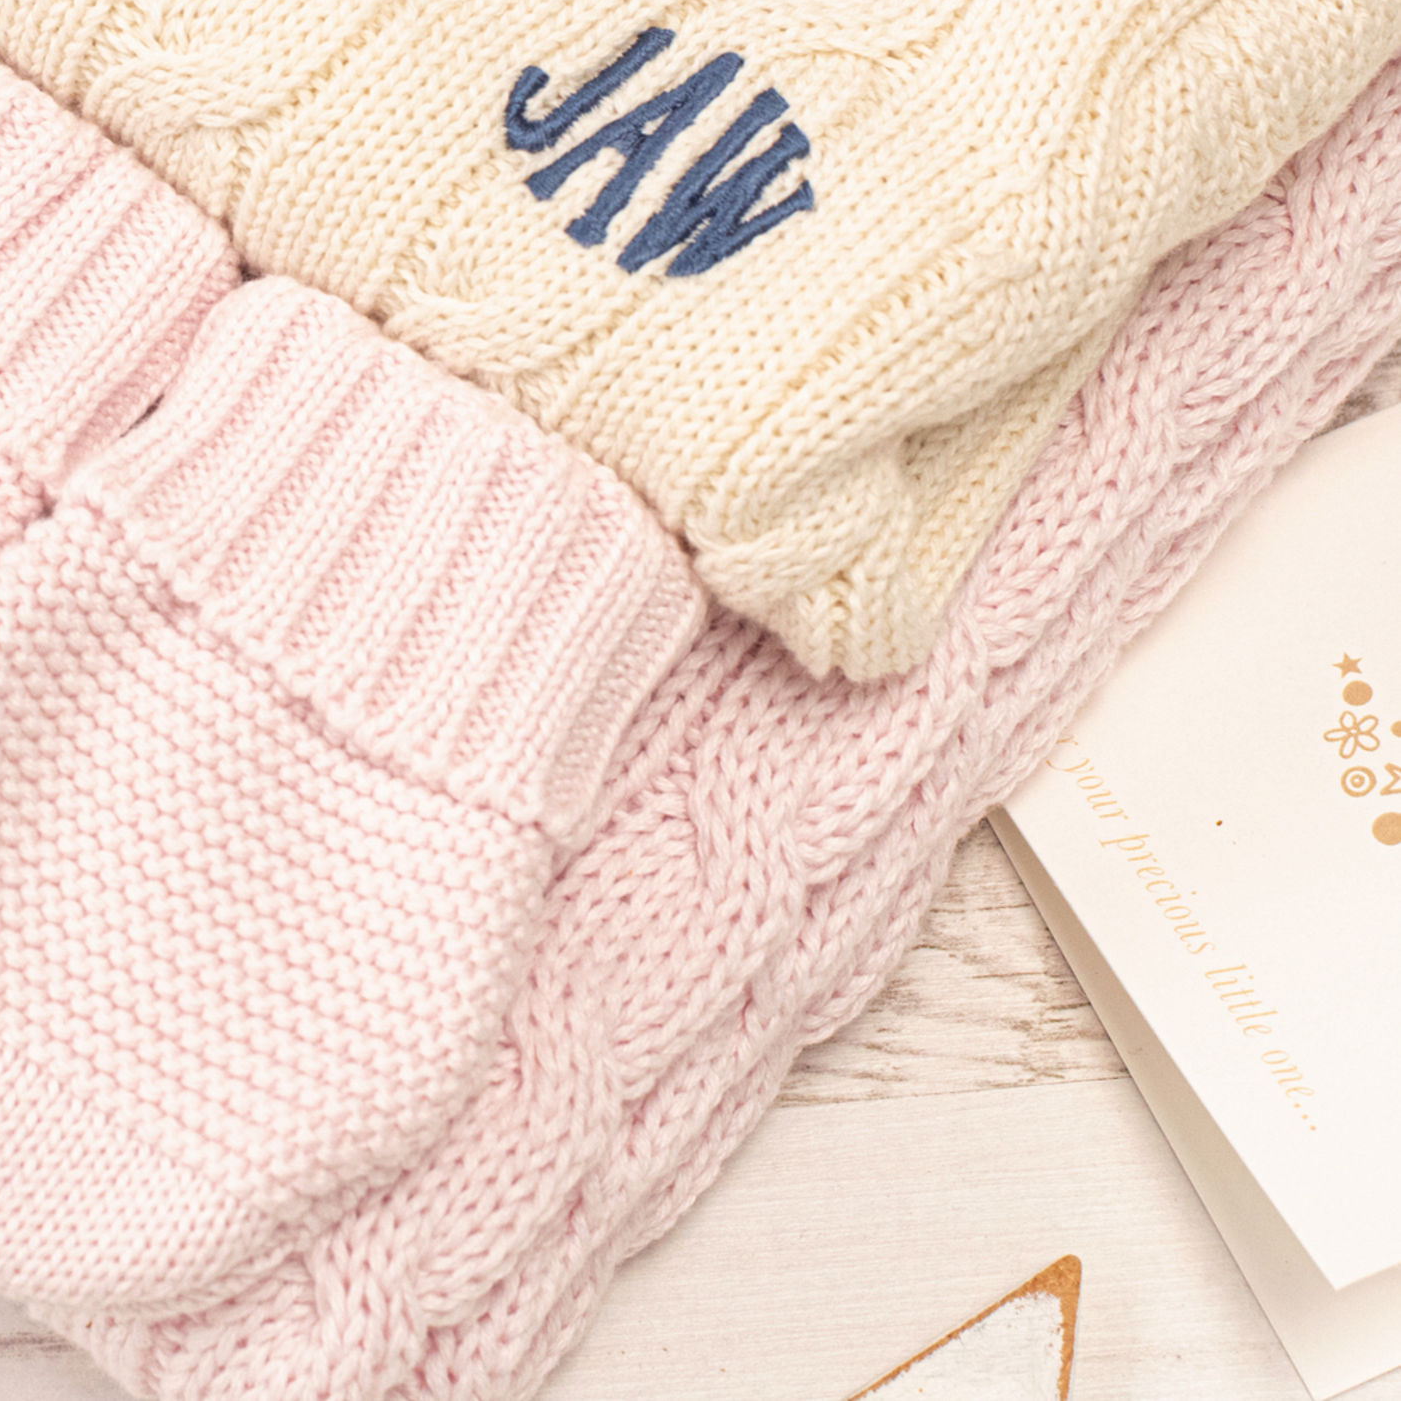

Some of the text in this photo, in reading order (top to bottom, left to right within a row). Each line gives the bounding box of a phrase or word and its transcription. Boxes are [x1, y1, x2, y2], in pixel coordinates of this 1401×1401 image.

[504, 26, 814, 277] JAW
[1045, 757, 1317, 1131] your precious little one...
